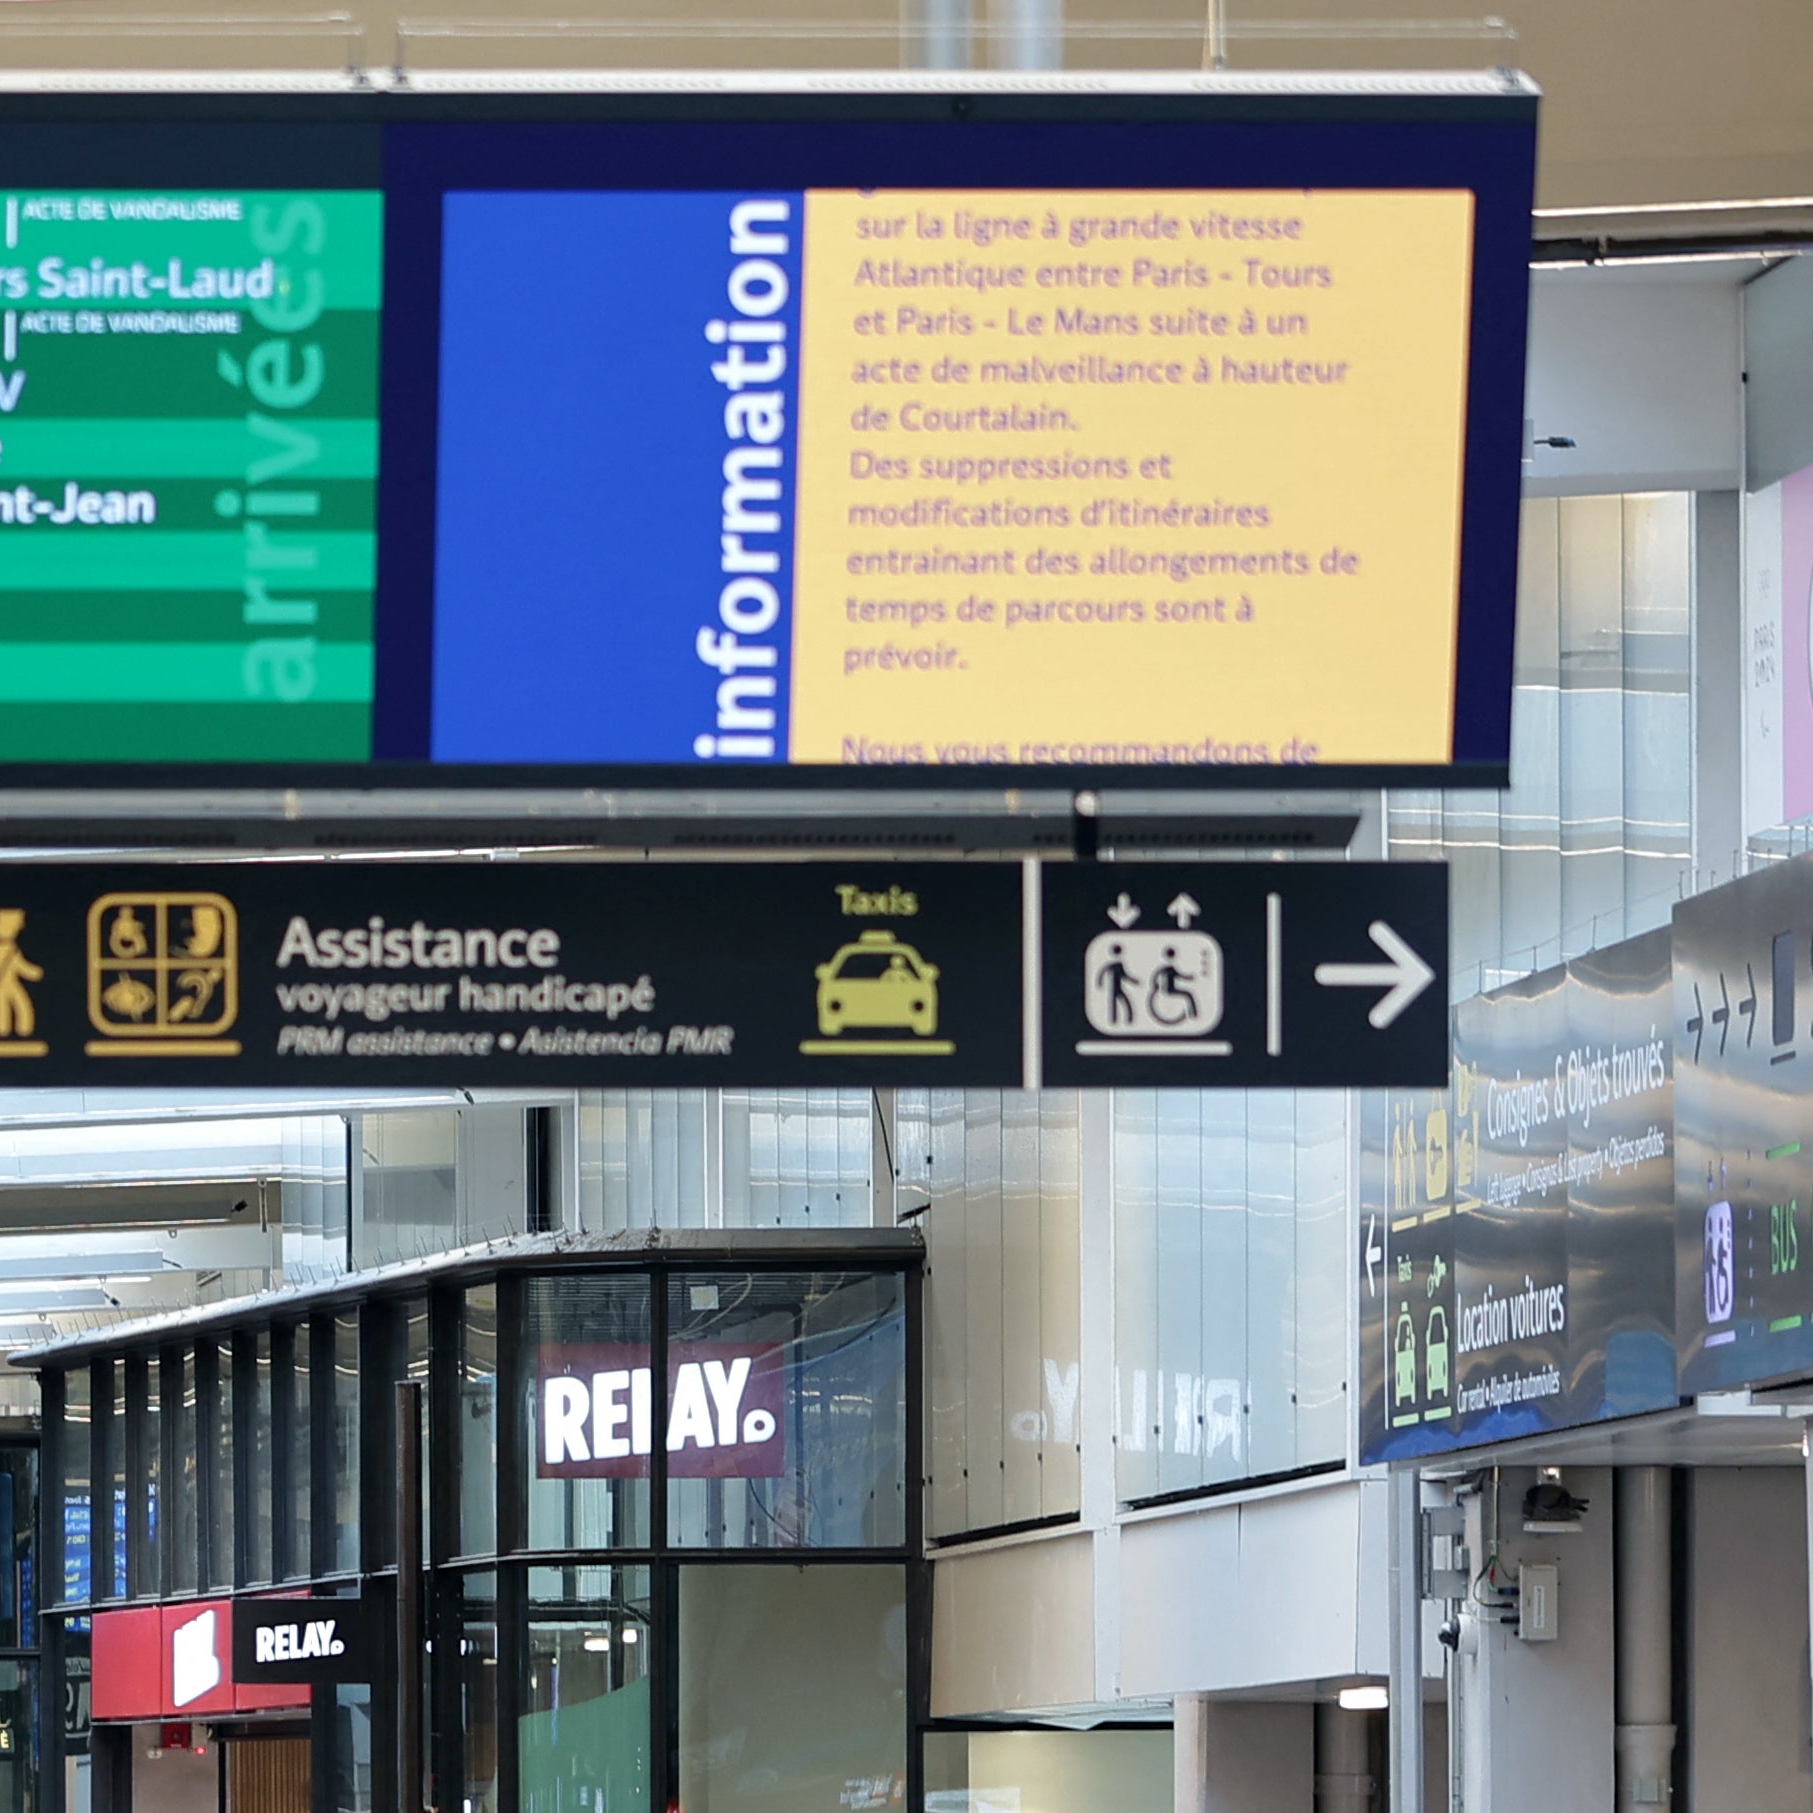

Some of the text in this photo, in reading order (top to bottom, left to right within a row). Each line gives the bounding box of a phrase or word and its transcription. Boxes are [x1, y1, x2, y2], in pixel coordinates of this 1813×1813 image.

[37, 258, 274, 299] Saint-Laud
[213, 199, 326, 702] arrivées
[693, 199, 790, 758] information
[834, 885, 918, 915] Taxis
[278, 918, 560, 969] Assistance
[278, 975, 654, 1019] voyageur handicapé
[1487, 1024, 1665, 1147] Consignes & Objets trouvés
[1772, 1199, 1798, 1275] BUS
[1458, 1274, 1564, 1353] Location voitures
